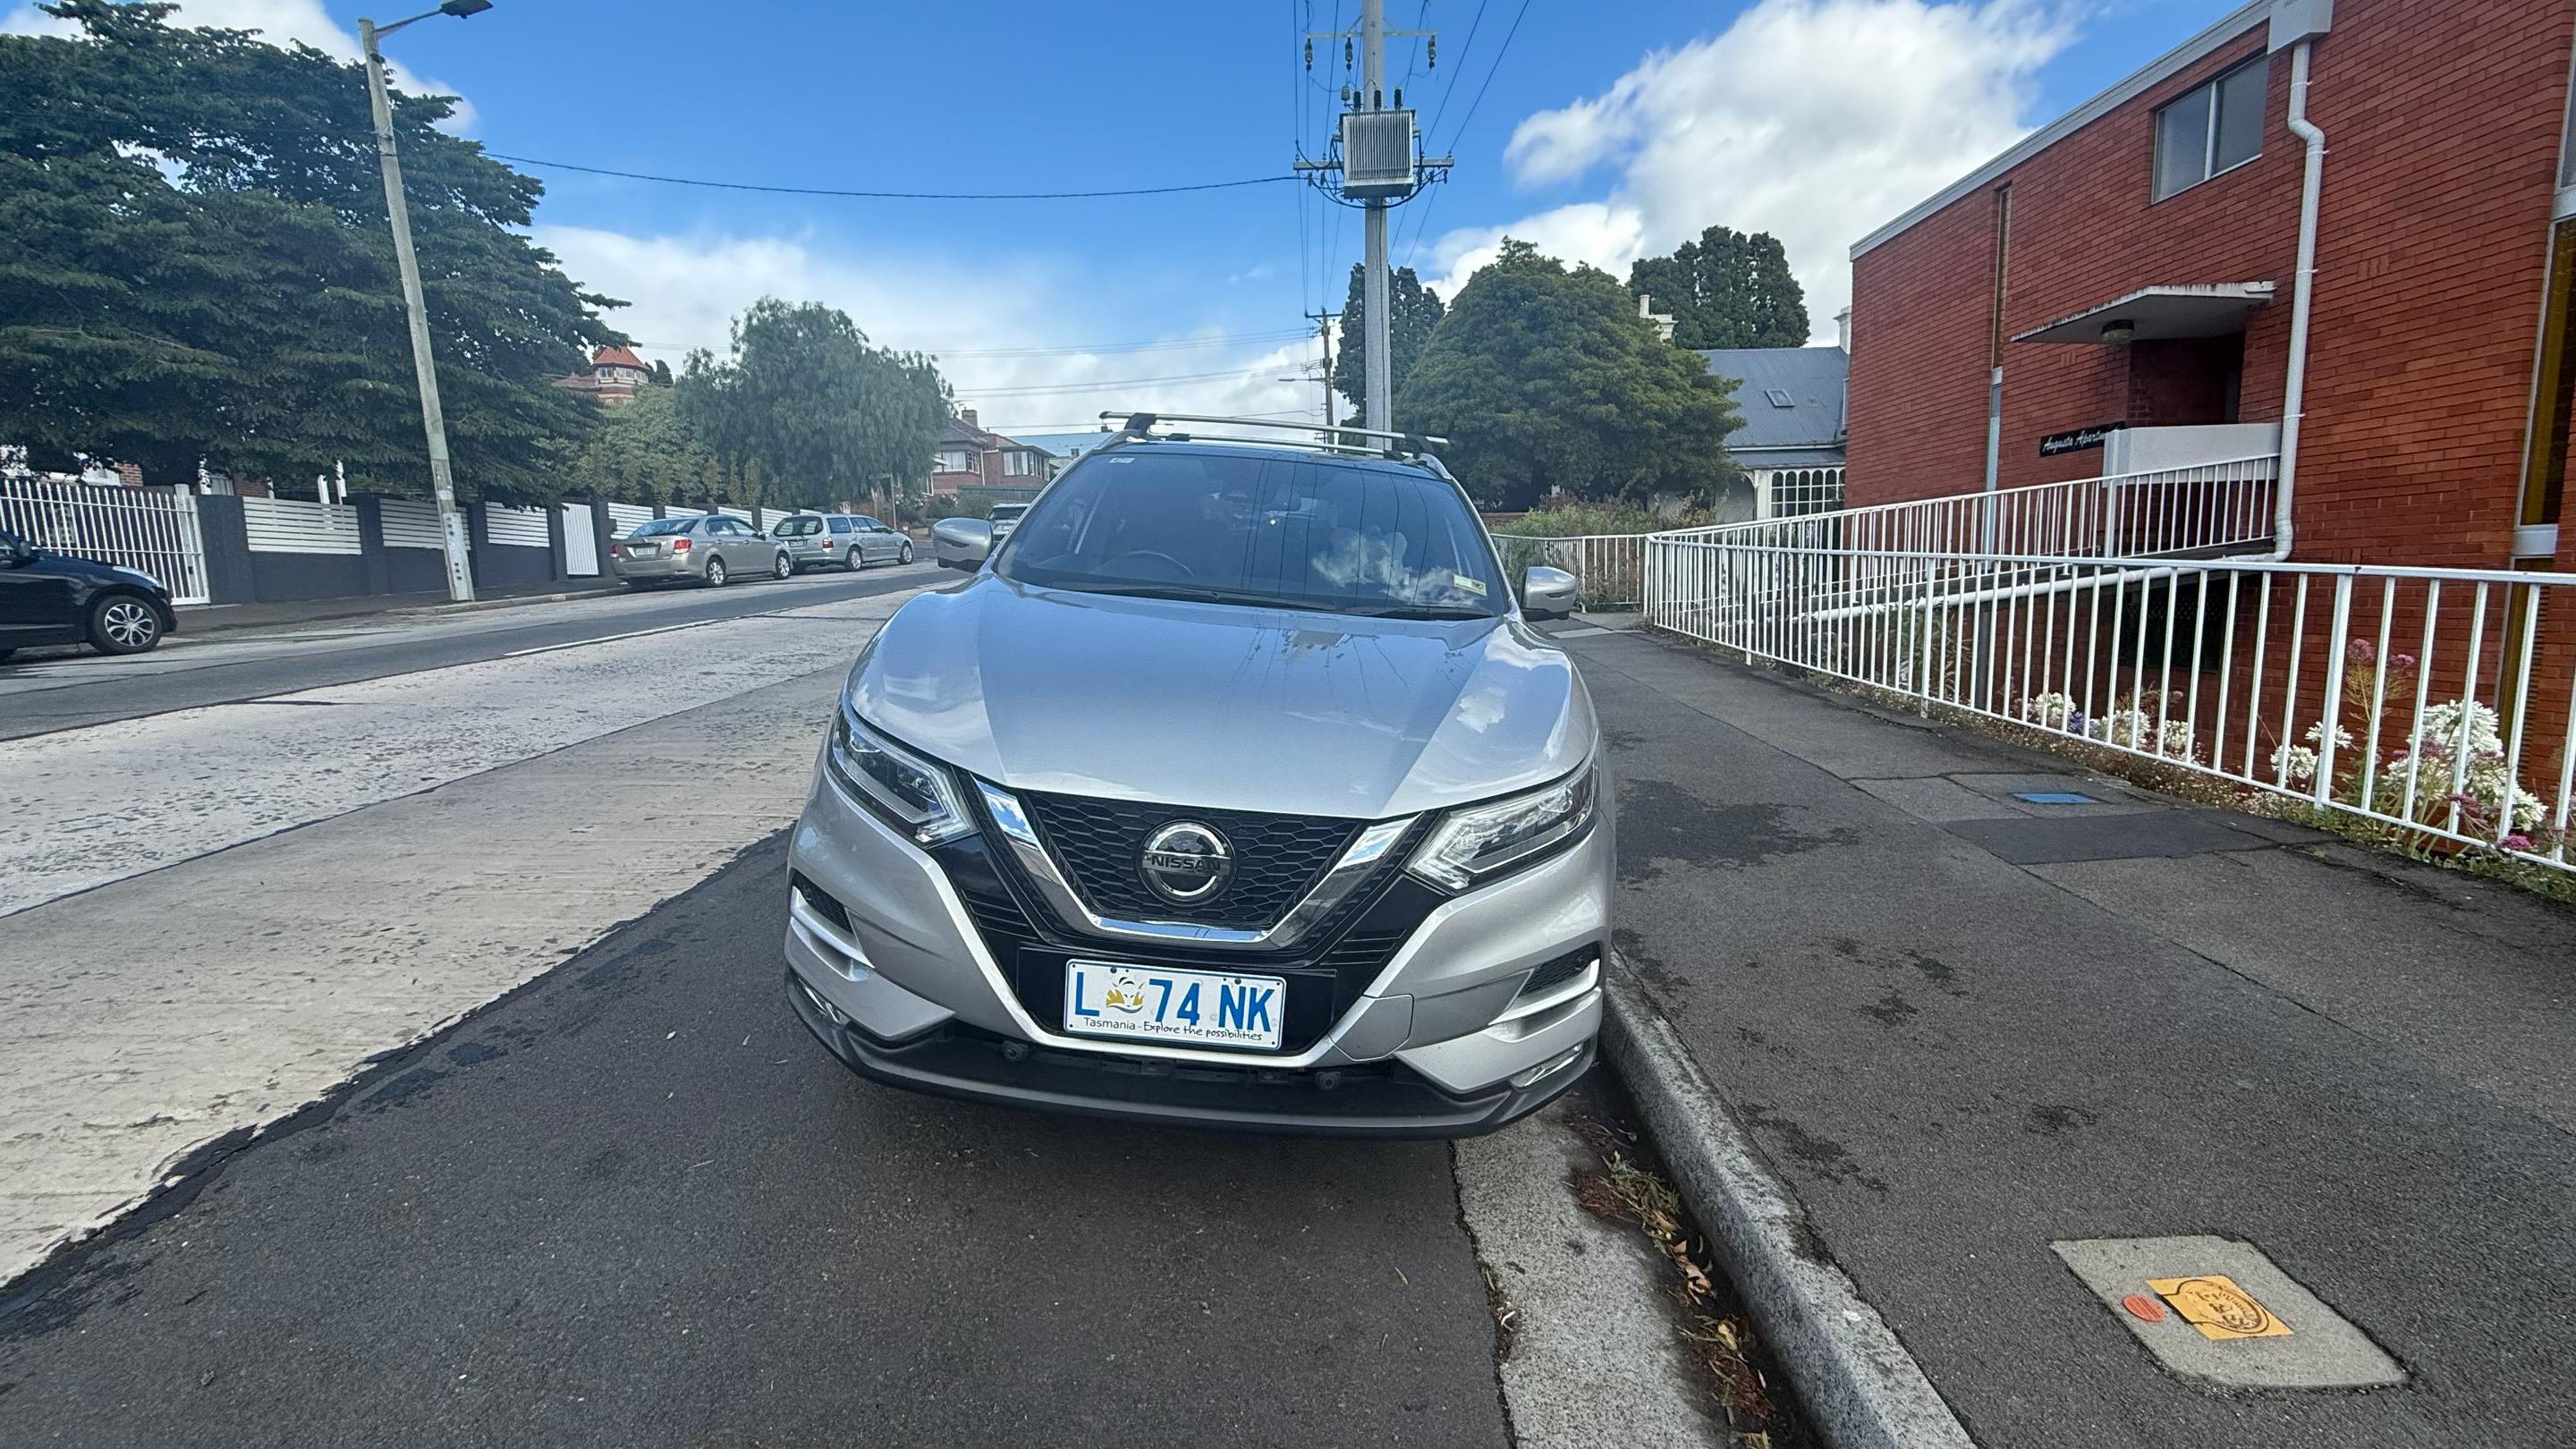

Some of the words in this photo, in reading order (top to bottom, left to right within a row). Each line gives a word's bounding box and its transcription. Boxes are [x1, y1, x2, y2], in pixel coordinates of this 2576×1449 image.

[1151, 855, 1220, 870] NISSAN
[1075, 972, 1100, 1017] L
[1148, 979, 1200, 1026] 74
[1218, 985, 1275, 1032] NK
[1084, 1018, 1136, 1030] Tasmania
[1143, 1021, 1181, 1035] Explore
[1183, 1026, 1203, 1036] the
[1206, 1029, 1262, 1041] possibilities
